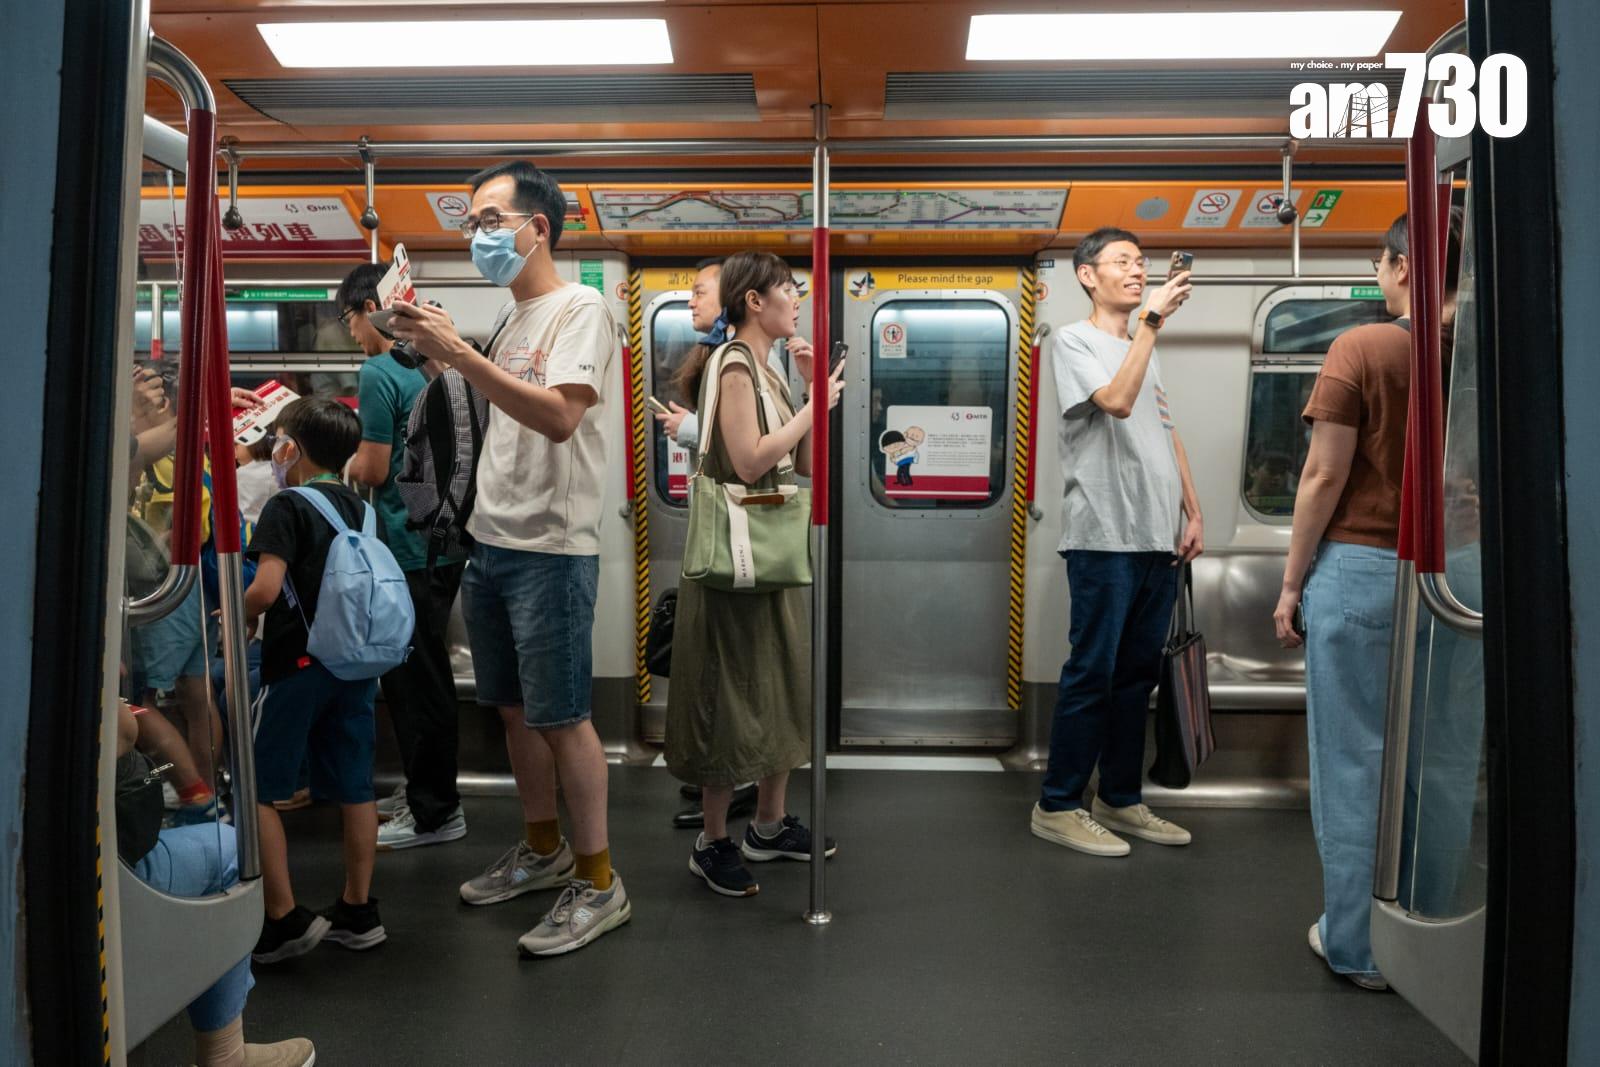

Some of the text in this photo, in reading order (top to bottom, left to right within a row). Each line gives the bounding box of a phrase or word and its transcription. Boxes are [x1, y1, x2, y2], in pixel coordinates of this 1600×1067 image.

[898, 274, 993, 284] Please mind the gap
